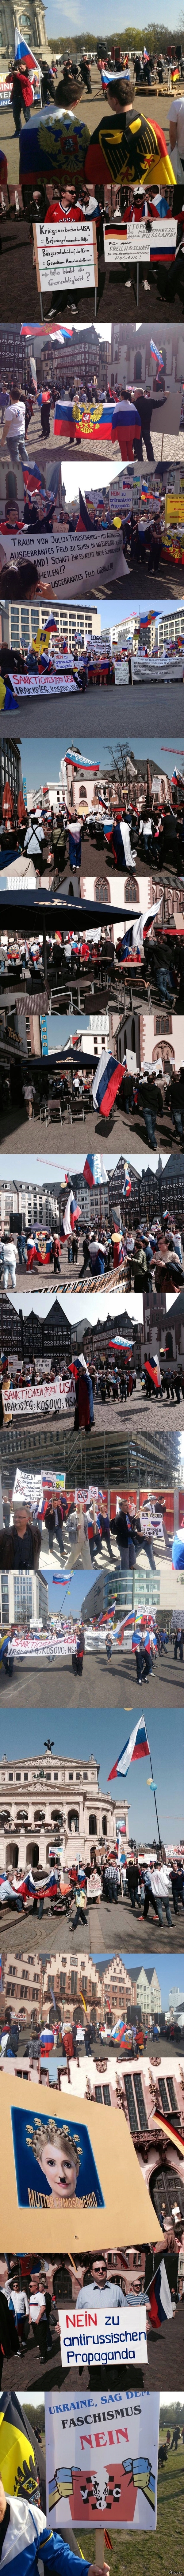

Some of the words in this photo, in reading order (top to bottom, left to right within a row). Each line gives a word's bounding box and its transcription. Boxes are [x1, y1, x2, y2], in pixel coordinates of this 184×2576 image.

[40, 225, 76, 235] Kriegsverbrechen
[42, 249, 70, 257] Bürgerentscheid
[51, 556, 69, 564] SCHAFT
[44, 1385, 57, 1397] gegen
[59, 1380, 75, 1394] USA
[65, 1397, 76, 1407] NSA
[64, 1635, 76, 1644] USA
[28, 2187, 54, 2207] MUTTER
[55, 2191, 97, 2207] TYMOSCHENKO
[66, 2311, 97, 2328] NEIN
[105, 2316, 120, 2325] zu
[63, 2331, 146, 2347] antirussischen
[67, 2348, 136, 2365] Propaganda
[48, 2399, 98, 2414] UKRAINE,
[101, 2393, 122, 2404] SAG
[61, 2405, 142, 2429] FASCHISMUS
[79, 2428, 130, 2450] NEIN
